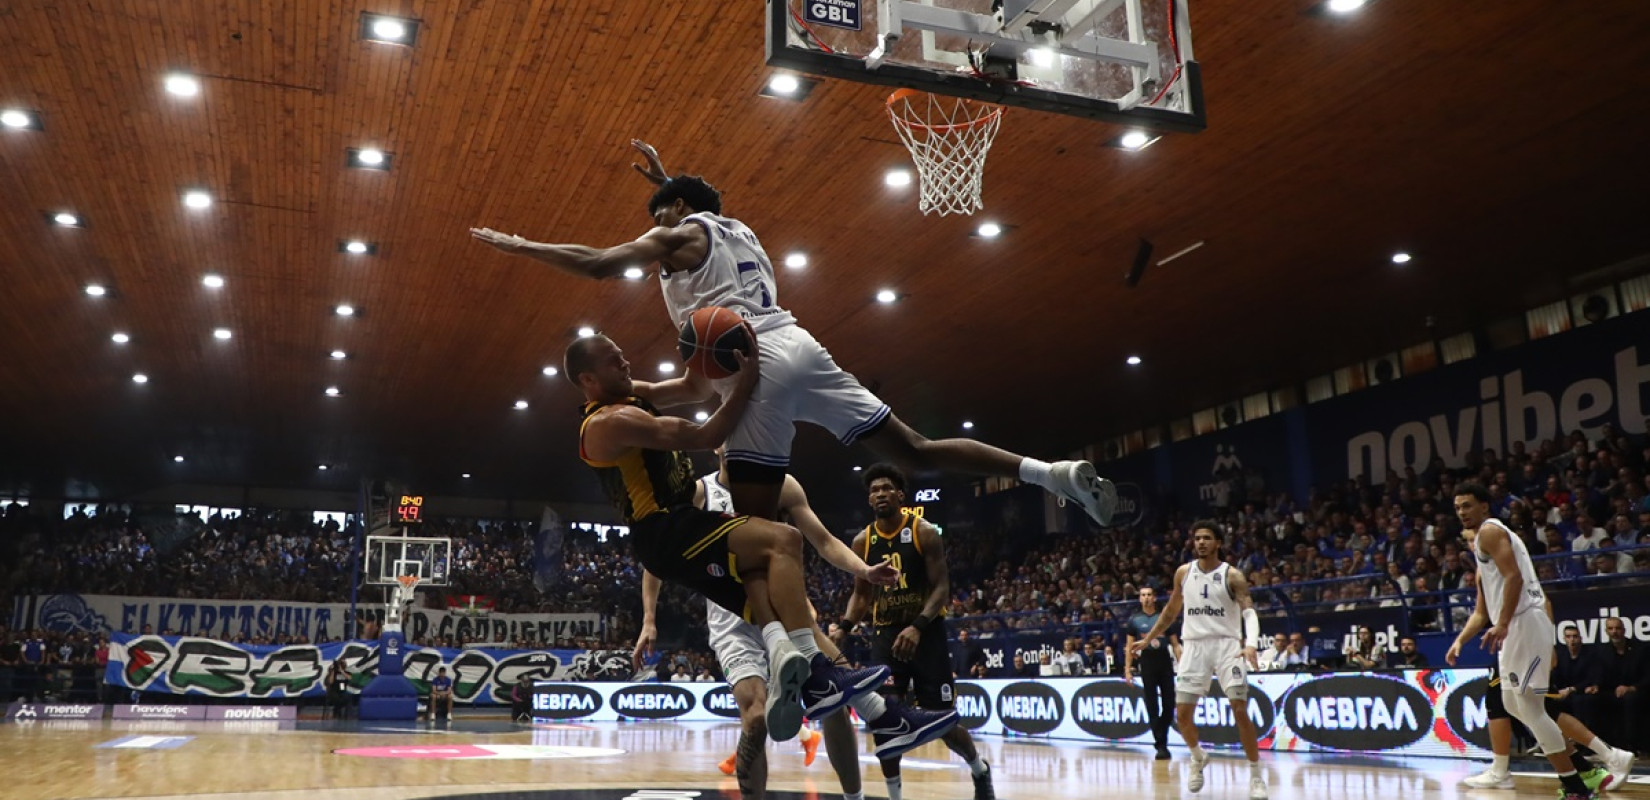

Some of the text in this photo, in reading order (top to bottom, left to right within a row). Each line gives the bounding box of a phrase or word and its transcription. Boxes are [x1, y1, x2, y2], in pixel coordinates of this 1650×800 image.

[811, 3, 855, 24] GBL
[1347, 345, 1650, 486] novibet
[915, 488, 941, 502] AEK
[1188, 605, 1225, 617] novibet
[44, 704, 93, 714] mentor
[224, 705, 280, 718] novibet
[618, 693, 689, 710] ΜΕΒΓΑΛ
[956, 696, 987, 717] ΒΓΑΛ
[1001, 696, 1059, 720] ΜΕΒΓΑΛ
[1078, 697, 1149, 723] ΜΕΒΓΑΛ
[1295, 697, 1418, 731] ΜΕΒΓΑΛ
